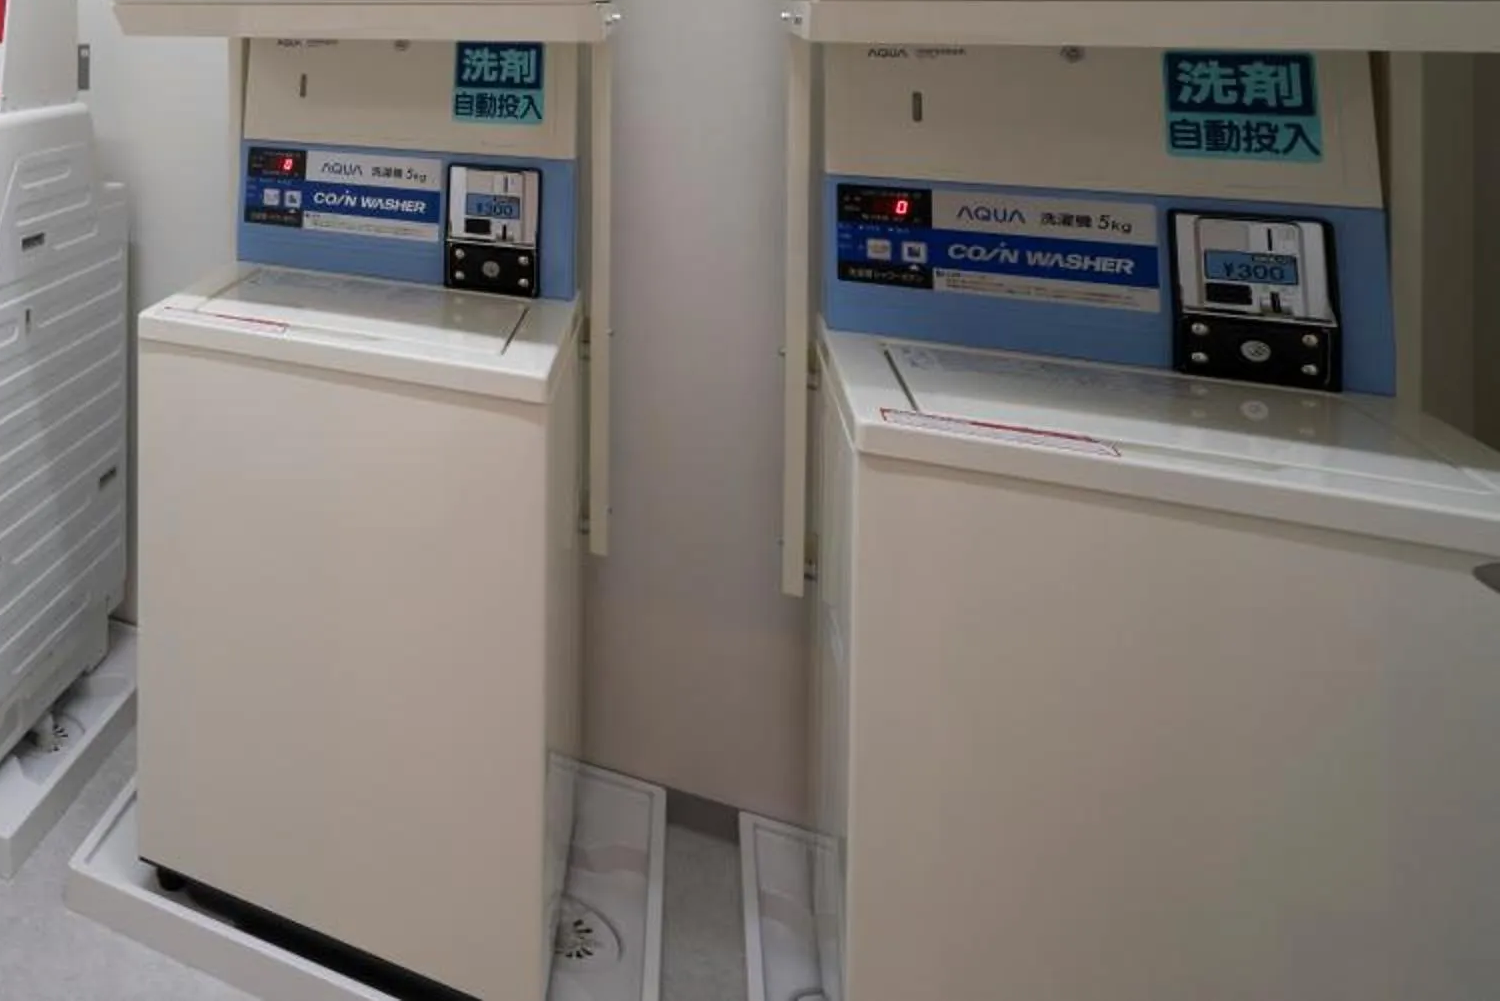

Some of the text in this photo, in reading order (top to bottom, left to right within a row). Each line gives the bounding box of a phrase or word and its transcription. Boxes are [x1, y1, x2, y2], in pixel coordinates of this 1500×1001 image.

[461, 47, 536, 85] 洗剤
[1176, 59, 1301, 108] 洗剤
[454, 93, 543, 121] 自動投入
[1169, 118, 1321, 157] 自動投入
[283, 158, 293, 171] 0
[321, 162, 363, 177] AQUA
[312, 189, 428, 215] COIN WASHER
[895, 199, 909, 215] 0
[956, 205, 1026, 224] AQUA
[1040, 212, 1133, 234] 洗濯機 5kg
[947, 241, 1135, 275] COIN WASHER
